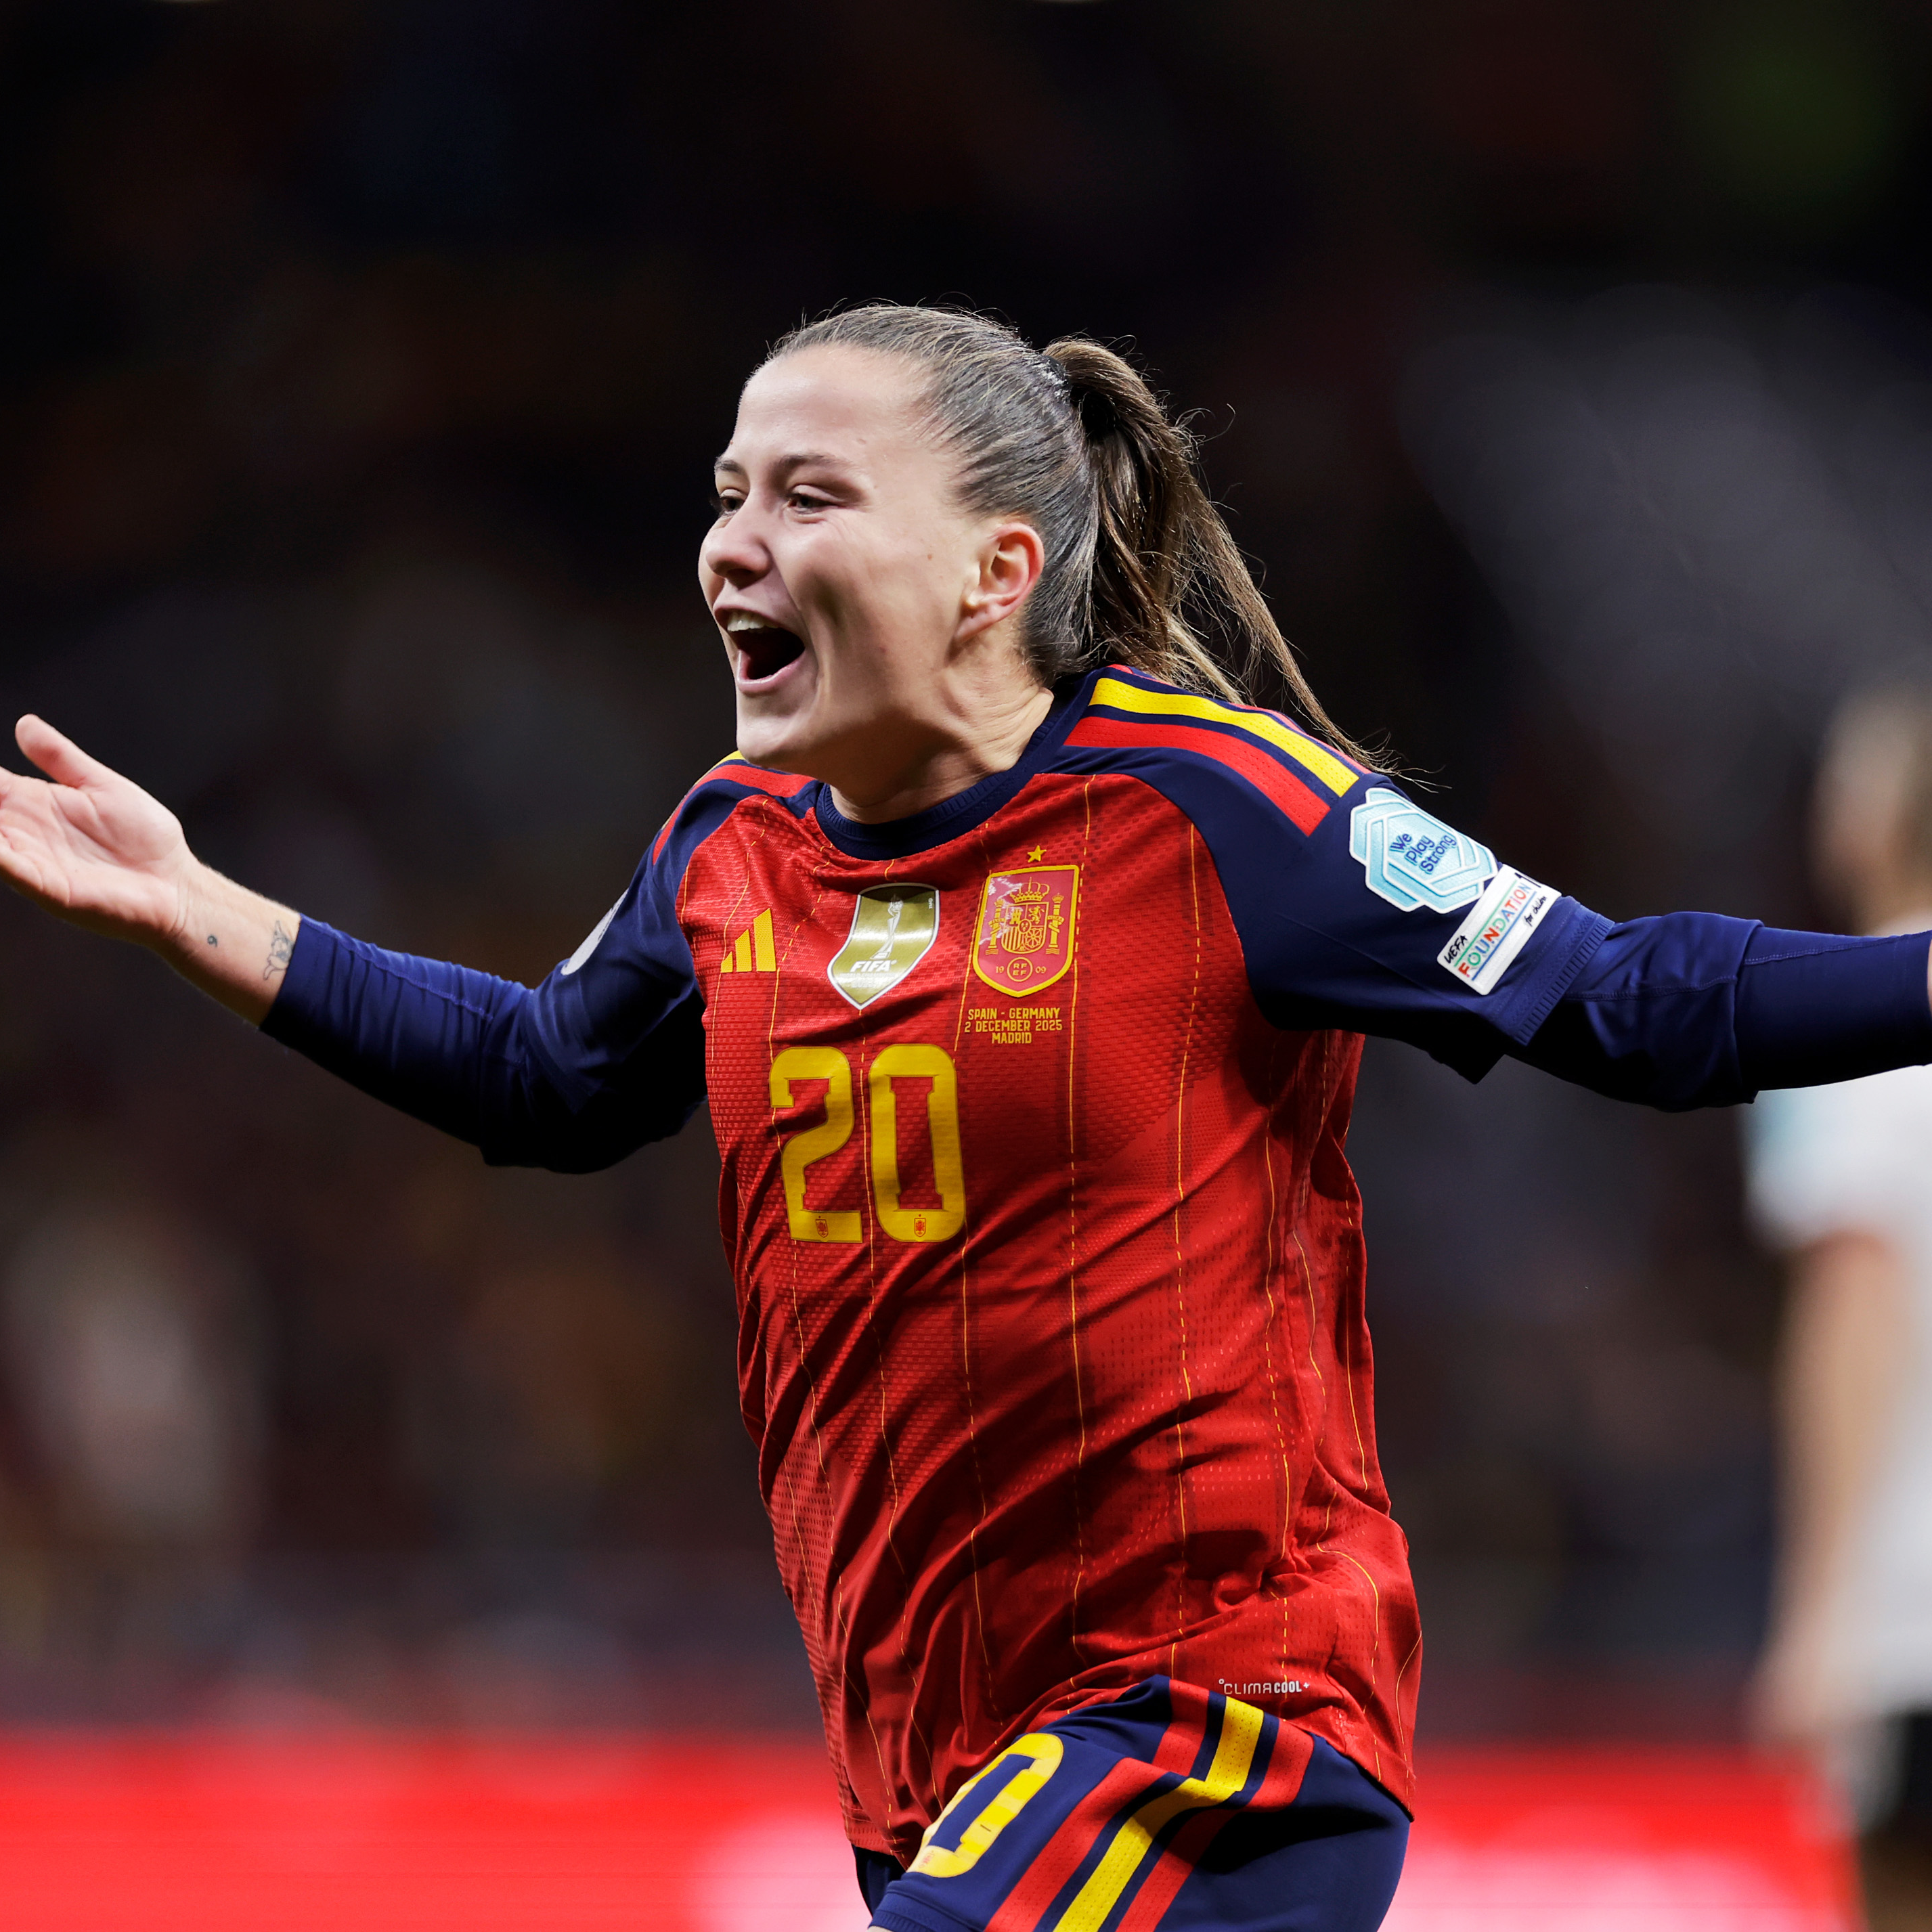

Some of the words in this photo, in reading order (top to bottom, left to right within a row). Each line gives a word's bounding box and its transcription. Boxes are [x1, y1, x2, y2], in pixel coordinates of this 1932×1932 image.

[1390, 833, 1412, 850] We
[1405, 835, 1435, 864] Play
[1420, 835, 1457, 873] Strong
[1443, 935, 1468, 964] UEFA
[849, 959, 892, 973] FIFA
[996, 965, 1005, 973] 19
[1035, 965, 1047, 974] 09
[967, 1008, 997, 1020] SPAIN
[1009, 1007, 1061, 1019] GERMANY
[964, 1021, 971, 1033] 2
[975, 1019, 1030, 1032] DECEMBER
[1035, 1019, 1063, 1032] 2025
[992, 1032, 1032, 1044] MADRID
[769, 1043, 967, 1244] 20
